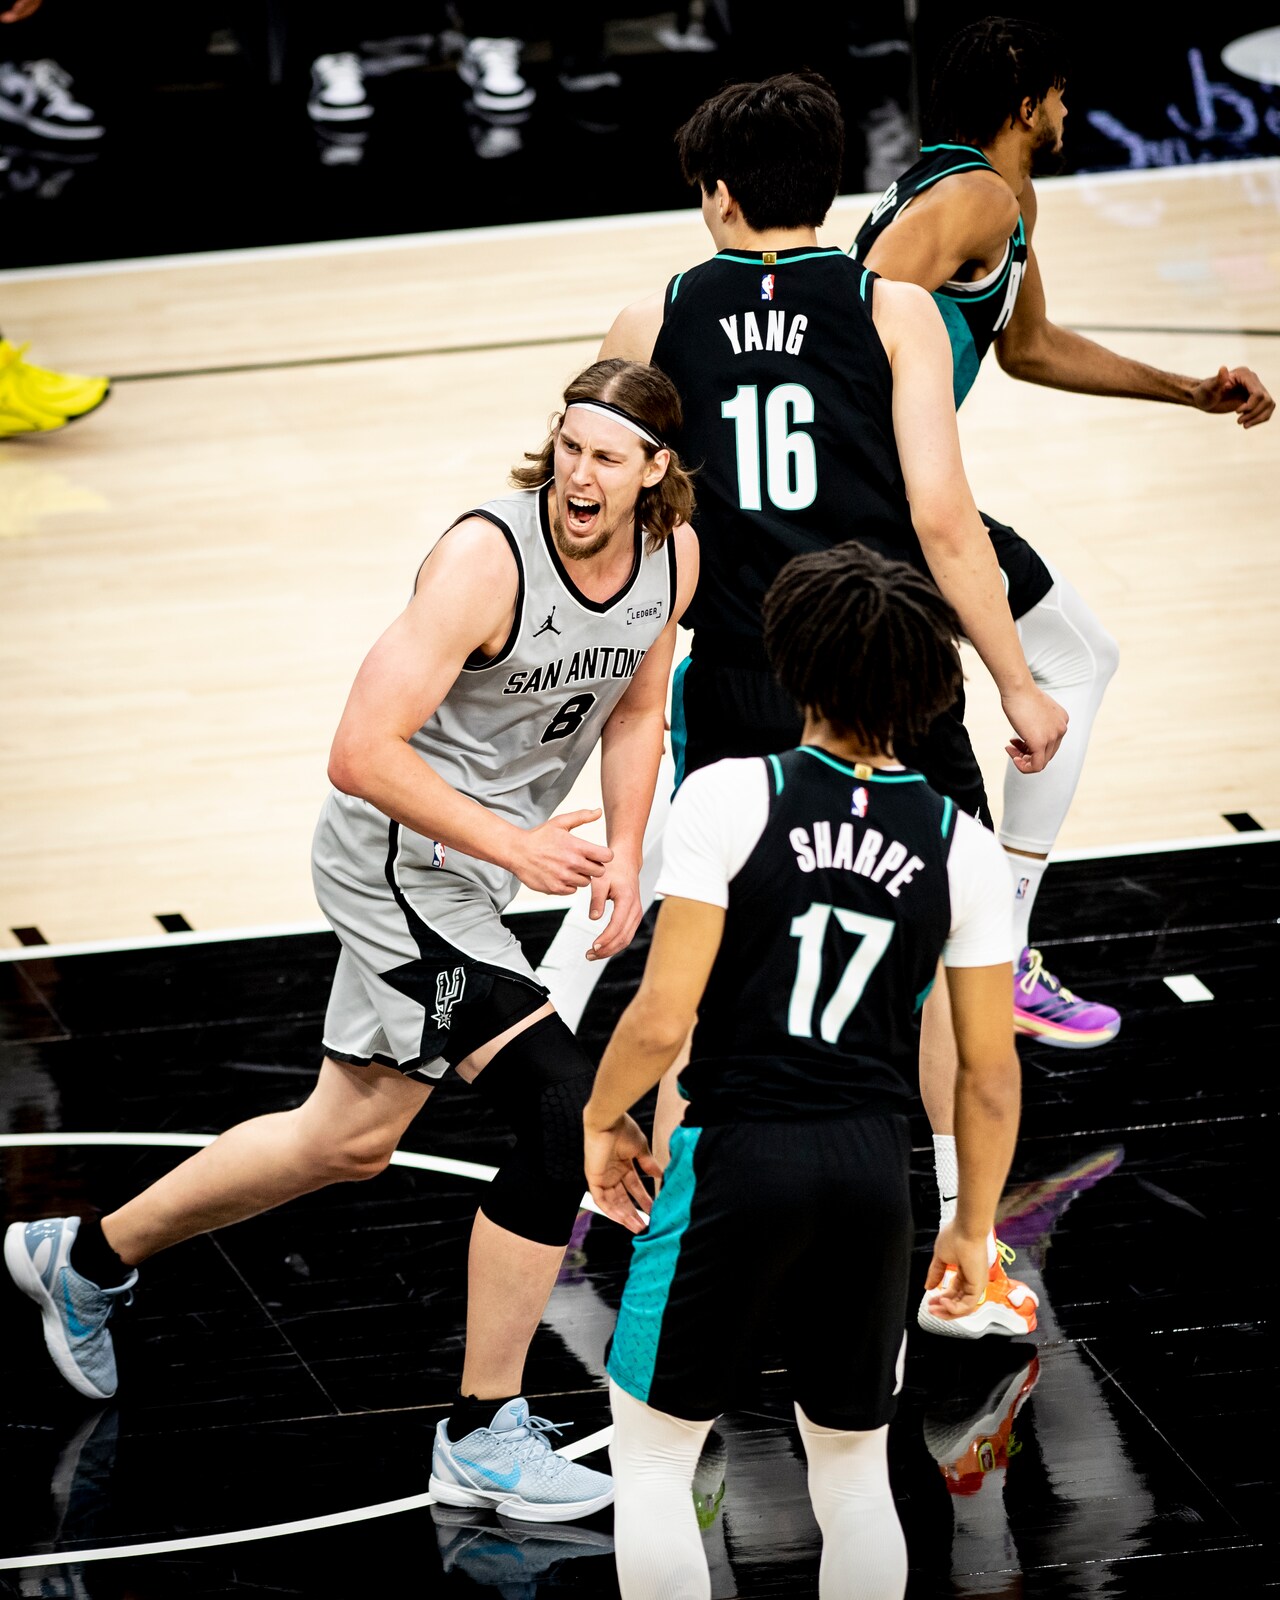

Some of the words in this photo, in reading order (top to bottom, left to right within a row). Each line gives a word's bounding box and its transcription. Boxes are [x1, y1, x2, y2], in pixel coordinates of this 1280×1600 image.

[719, 309, 808, 356] YANG
[720, 382, 818, 511] 16
[630, 607, 658, 620] LEDGER
[502, 657, 564, 695] SAN
[539, 691, 598, 745] 8
[788, 820, 926, 898] SHARPE
[787, 901, 896, 1044] 17
